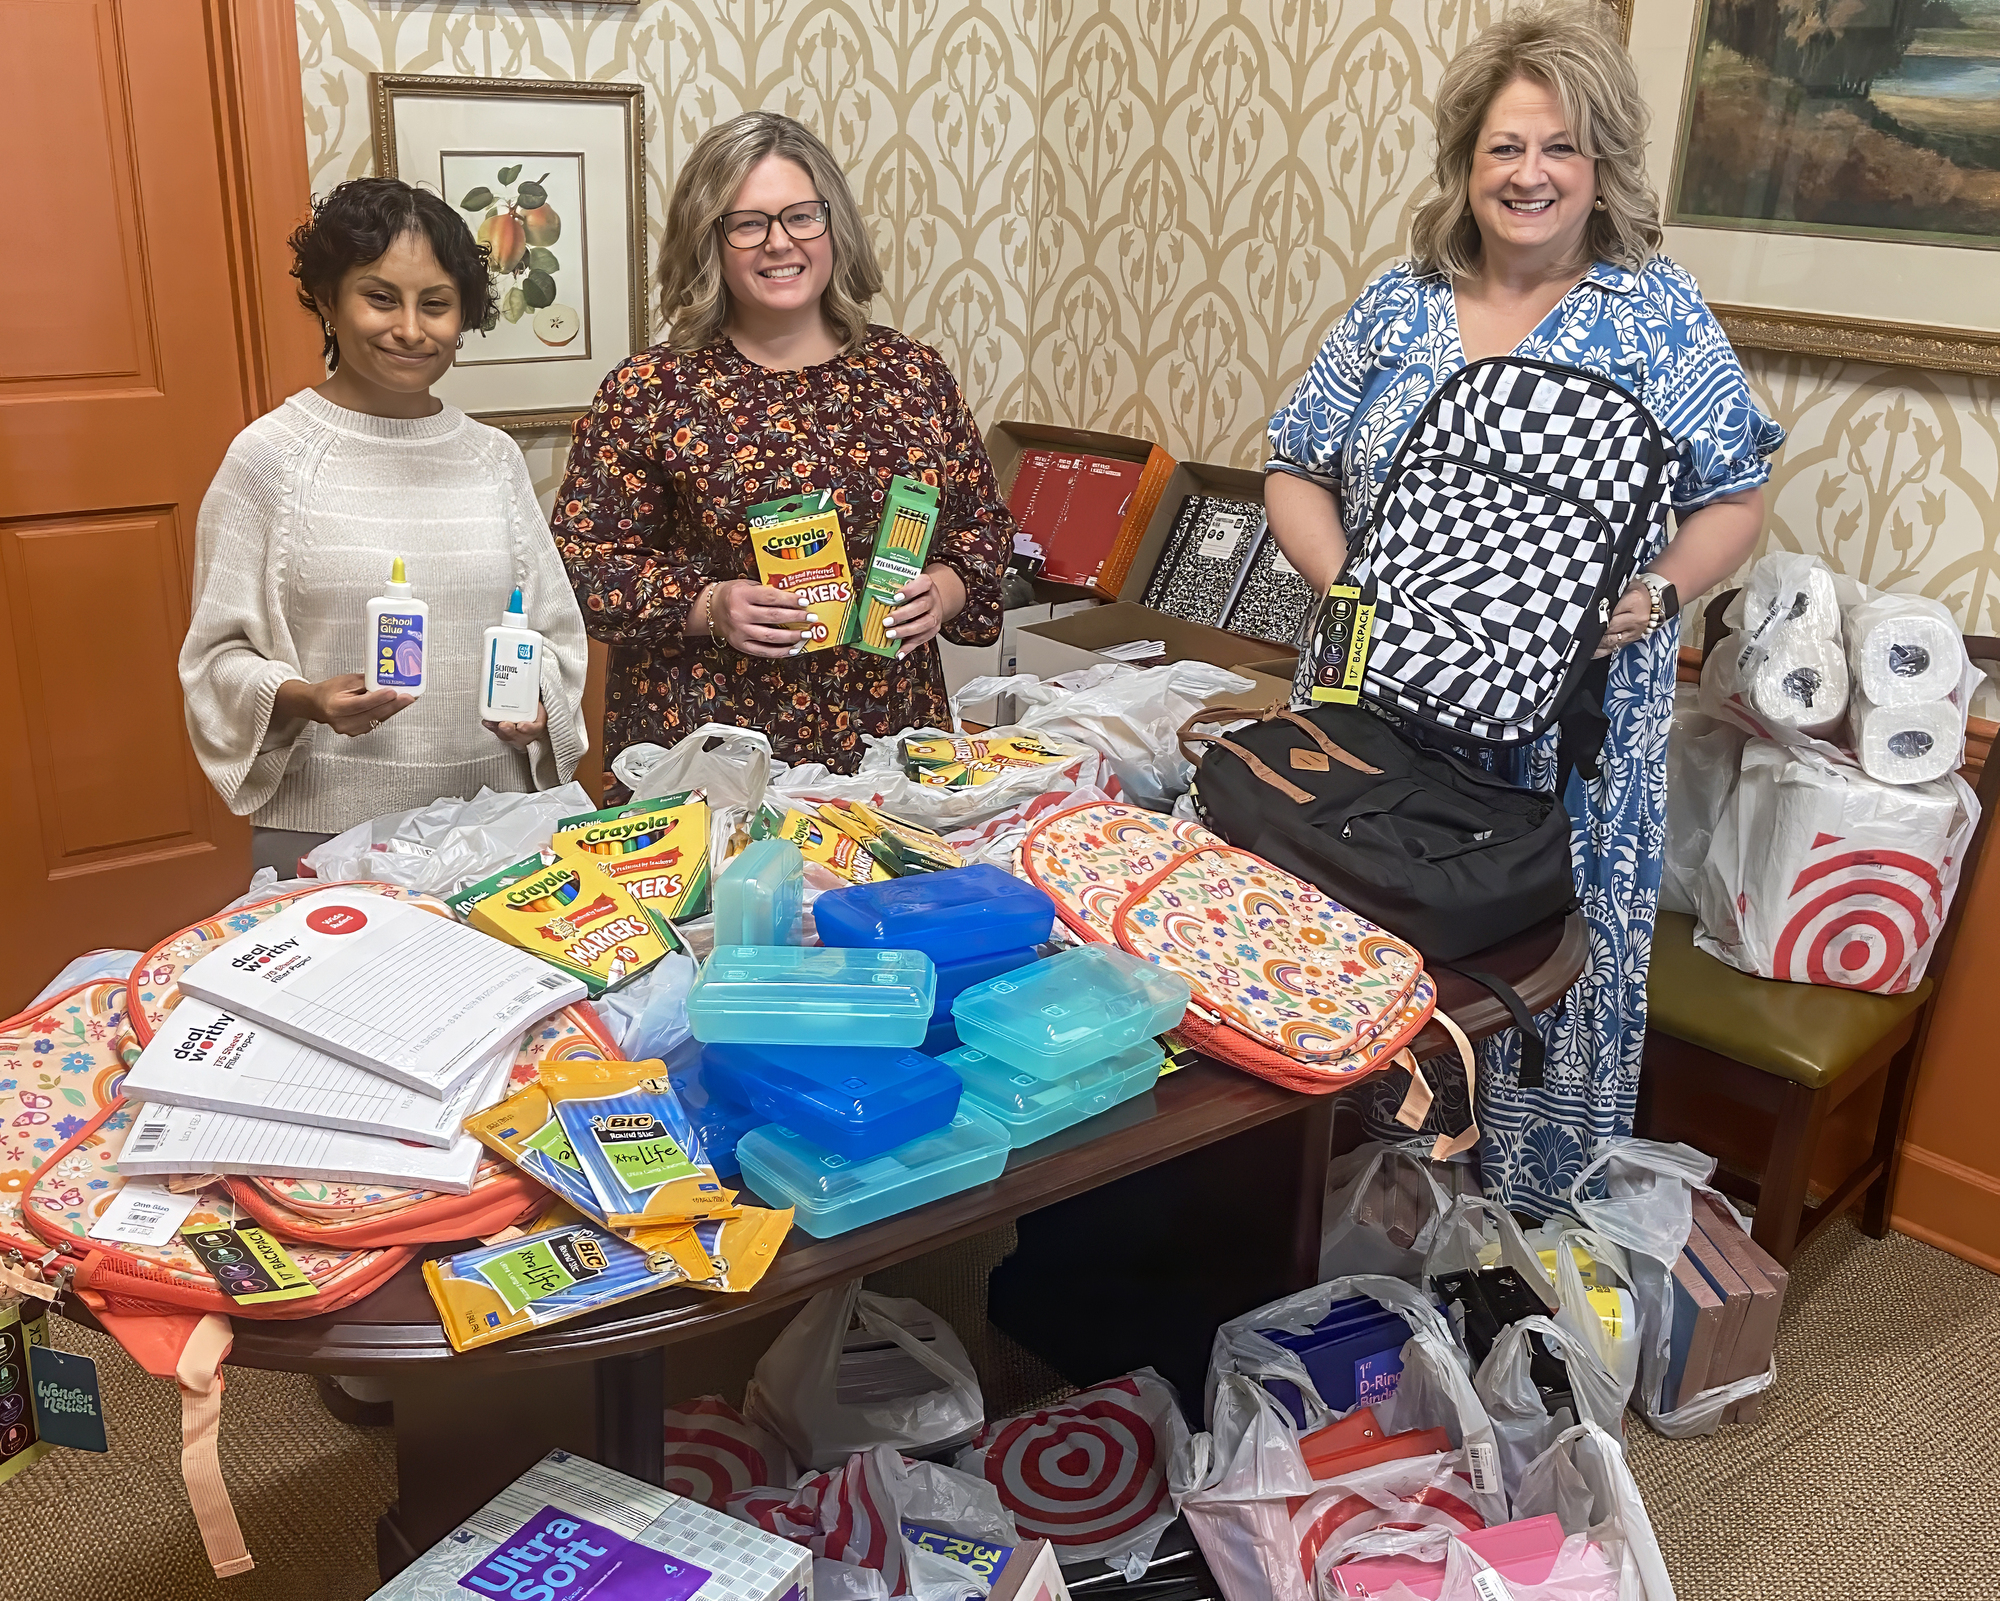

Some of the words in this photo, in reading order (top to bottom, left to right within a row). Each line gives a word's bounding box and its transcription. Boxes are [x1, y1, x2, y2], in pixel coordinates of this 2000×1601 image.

[750, 516, 763, 528] 10
[767, 528, 826, 549] Crayola
[795, 582, 851, 604] RKERS
[380, 615, 413, 626] School
[1353, 609, 1370, 663] BACKPACK
[585, 817, 669, 841] Crayola
[507, 868, 571, 905] Crayola
[624, 874, 684, 900] KERS
[564, 914, 651, 967] MARKERS
[617, 946, 637, 961] 10
[231, 943, 269, 968] deal
[243, 938, 300, 972] worthy
[173, 1027, 206, 1060] deal
[188, 1013, 236, 1062] worthy
[610, 1116, 650, 1128] BIC
[637, 1144, 678, 1166] Life
[133, 1201, 151, 1209] One
[245, 1229, 287, 1270] BACKPACK
[577, 1241, 603, 1267] BIC
[523, 1264, 560, 1292] Life
[37, 1380, 94, 1404] Wonder
[468, 1517, 583, 1592] Ultra
[510, 1538, 608, 1601] Soft
